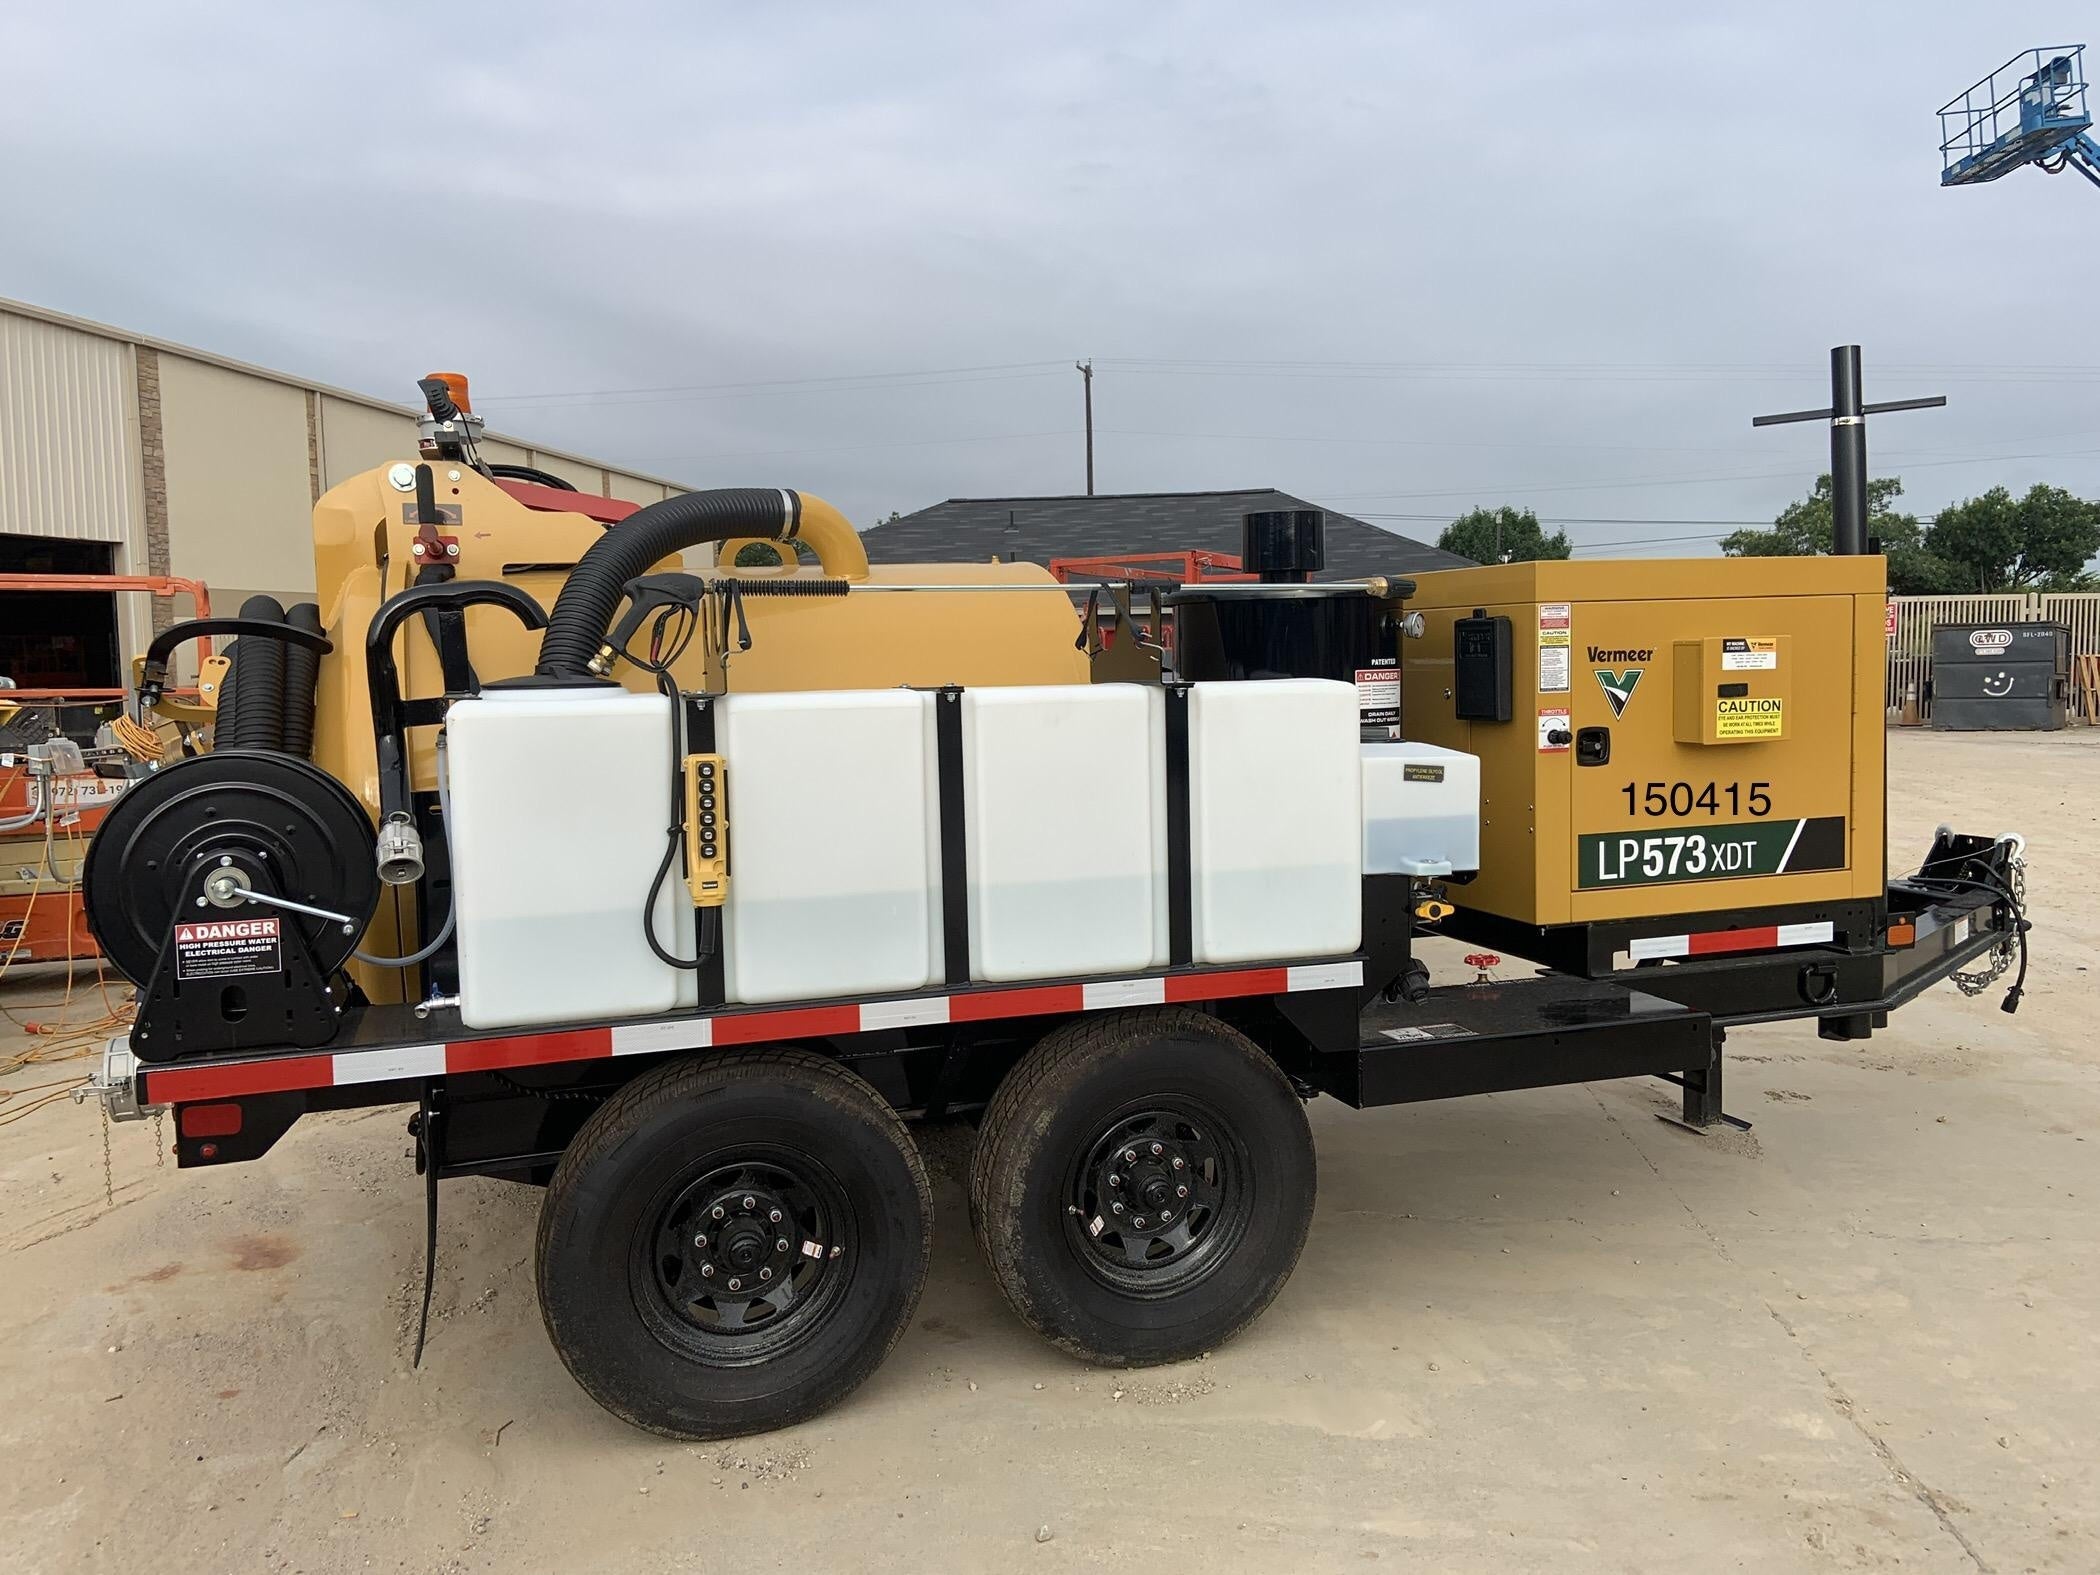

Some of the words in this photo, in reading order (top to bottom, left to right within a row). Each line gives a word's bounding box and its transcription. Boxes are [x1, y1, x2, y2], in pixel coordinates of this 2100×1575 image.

[1587, 646, 1653, 662] Vermeer
[1371, 658, 1396, 666] PATENTED
[1364, 672, 1398, 681] DANGER
[1718, 700, 1781, 713] CAUTION
[1622, 782, 1772, 816] 150415
[196, 921, 276, 939] DANGER
[179, 942, 201, 951] HIGH
[202, 939, 247, 949] PRESSURE
[248, 937, 278, 945] WATER
[185, 948, 236, 957] ELECTRICAL
[238, 945, 272, 953] DANGER
